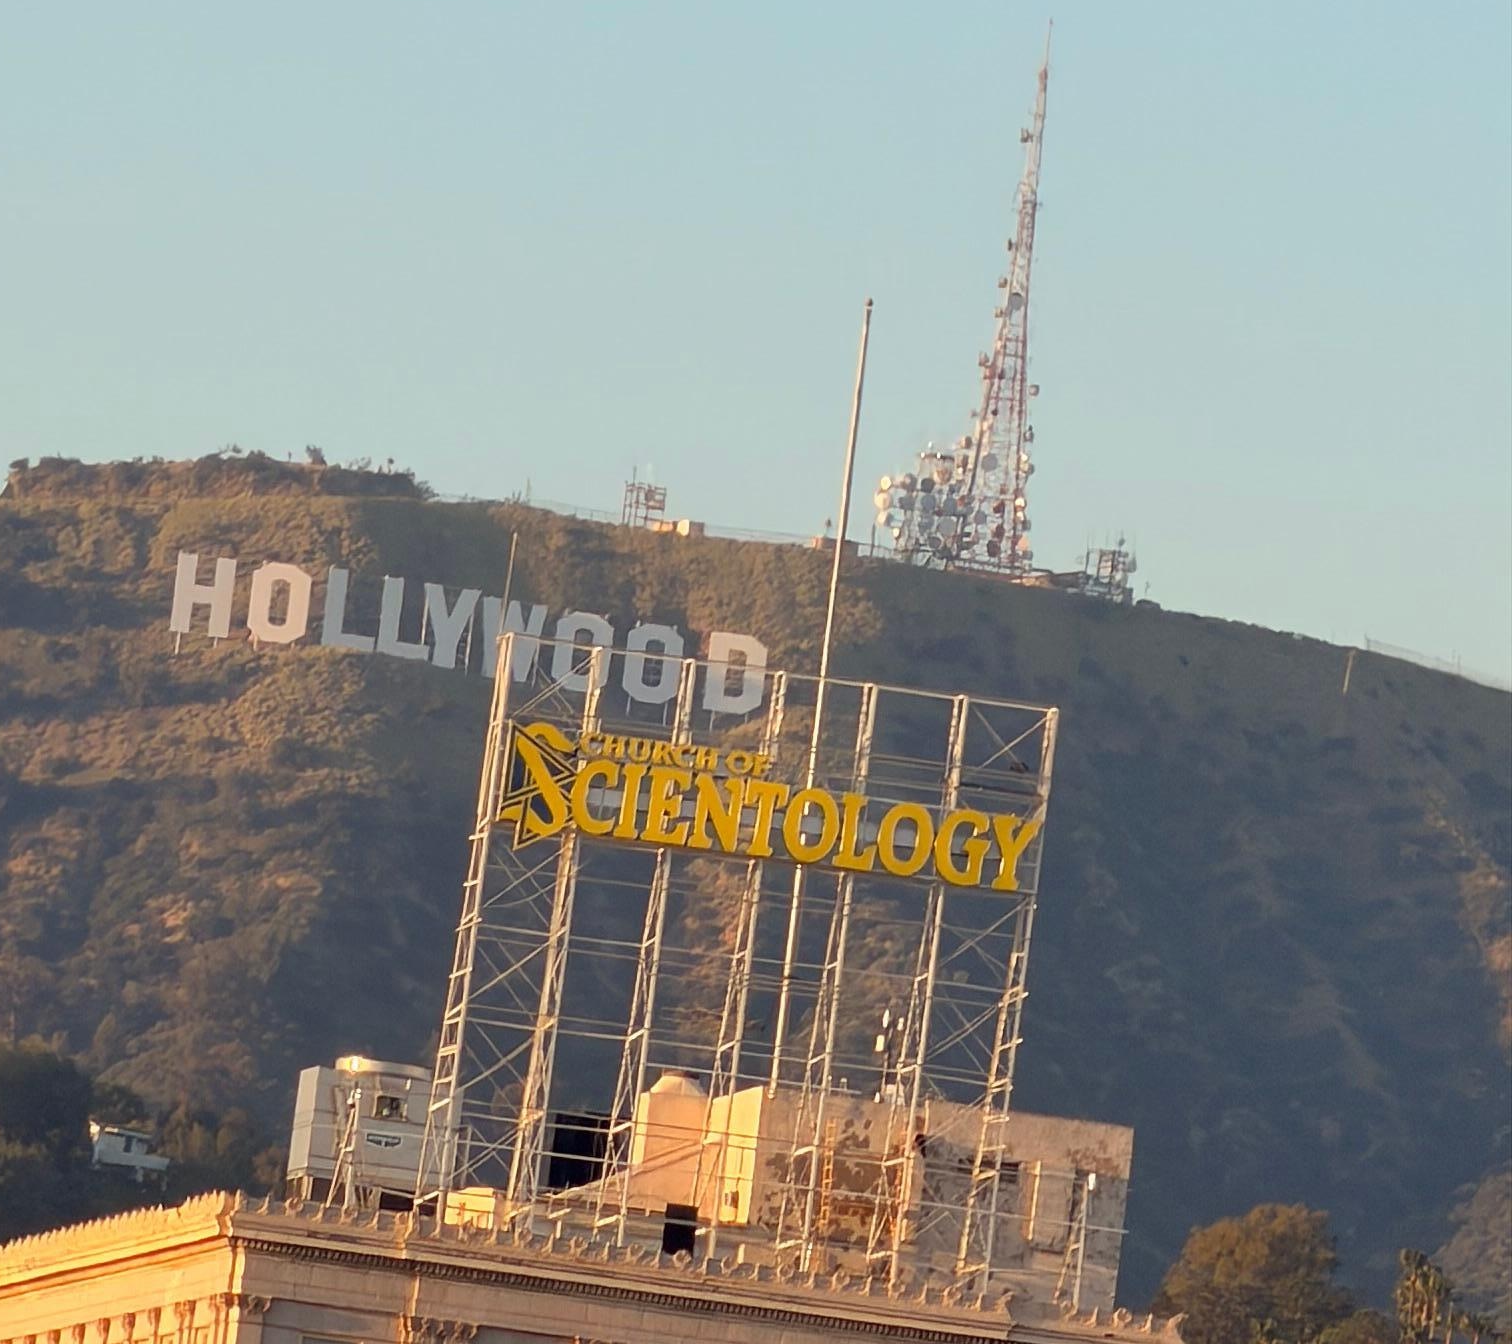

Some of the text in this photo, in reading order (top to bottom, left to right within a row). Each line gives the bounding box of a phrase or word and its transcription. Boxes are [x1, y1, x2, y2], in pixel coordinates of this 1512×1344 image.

[170, 552, 767, 715] HOLLYWOOD
[499, 722, 1042, 892] SCIENTOLOGY
[580, 733, 774, 777] CHURCH OF
